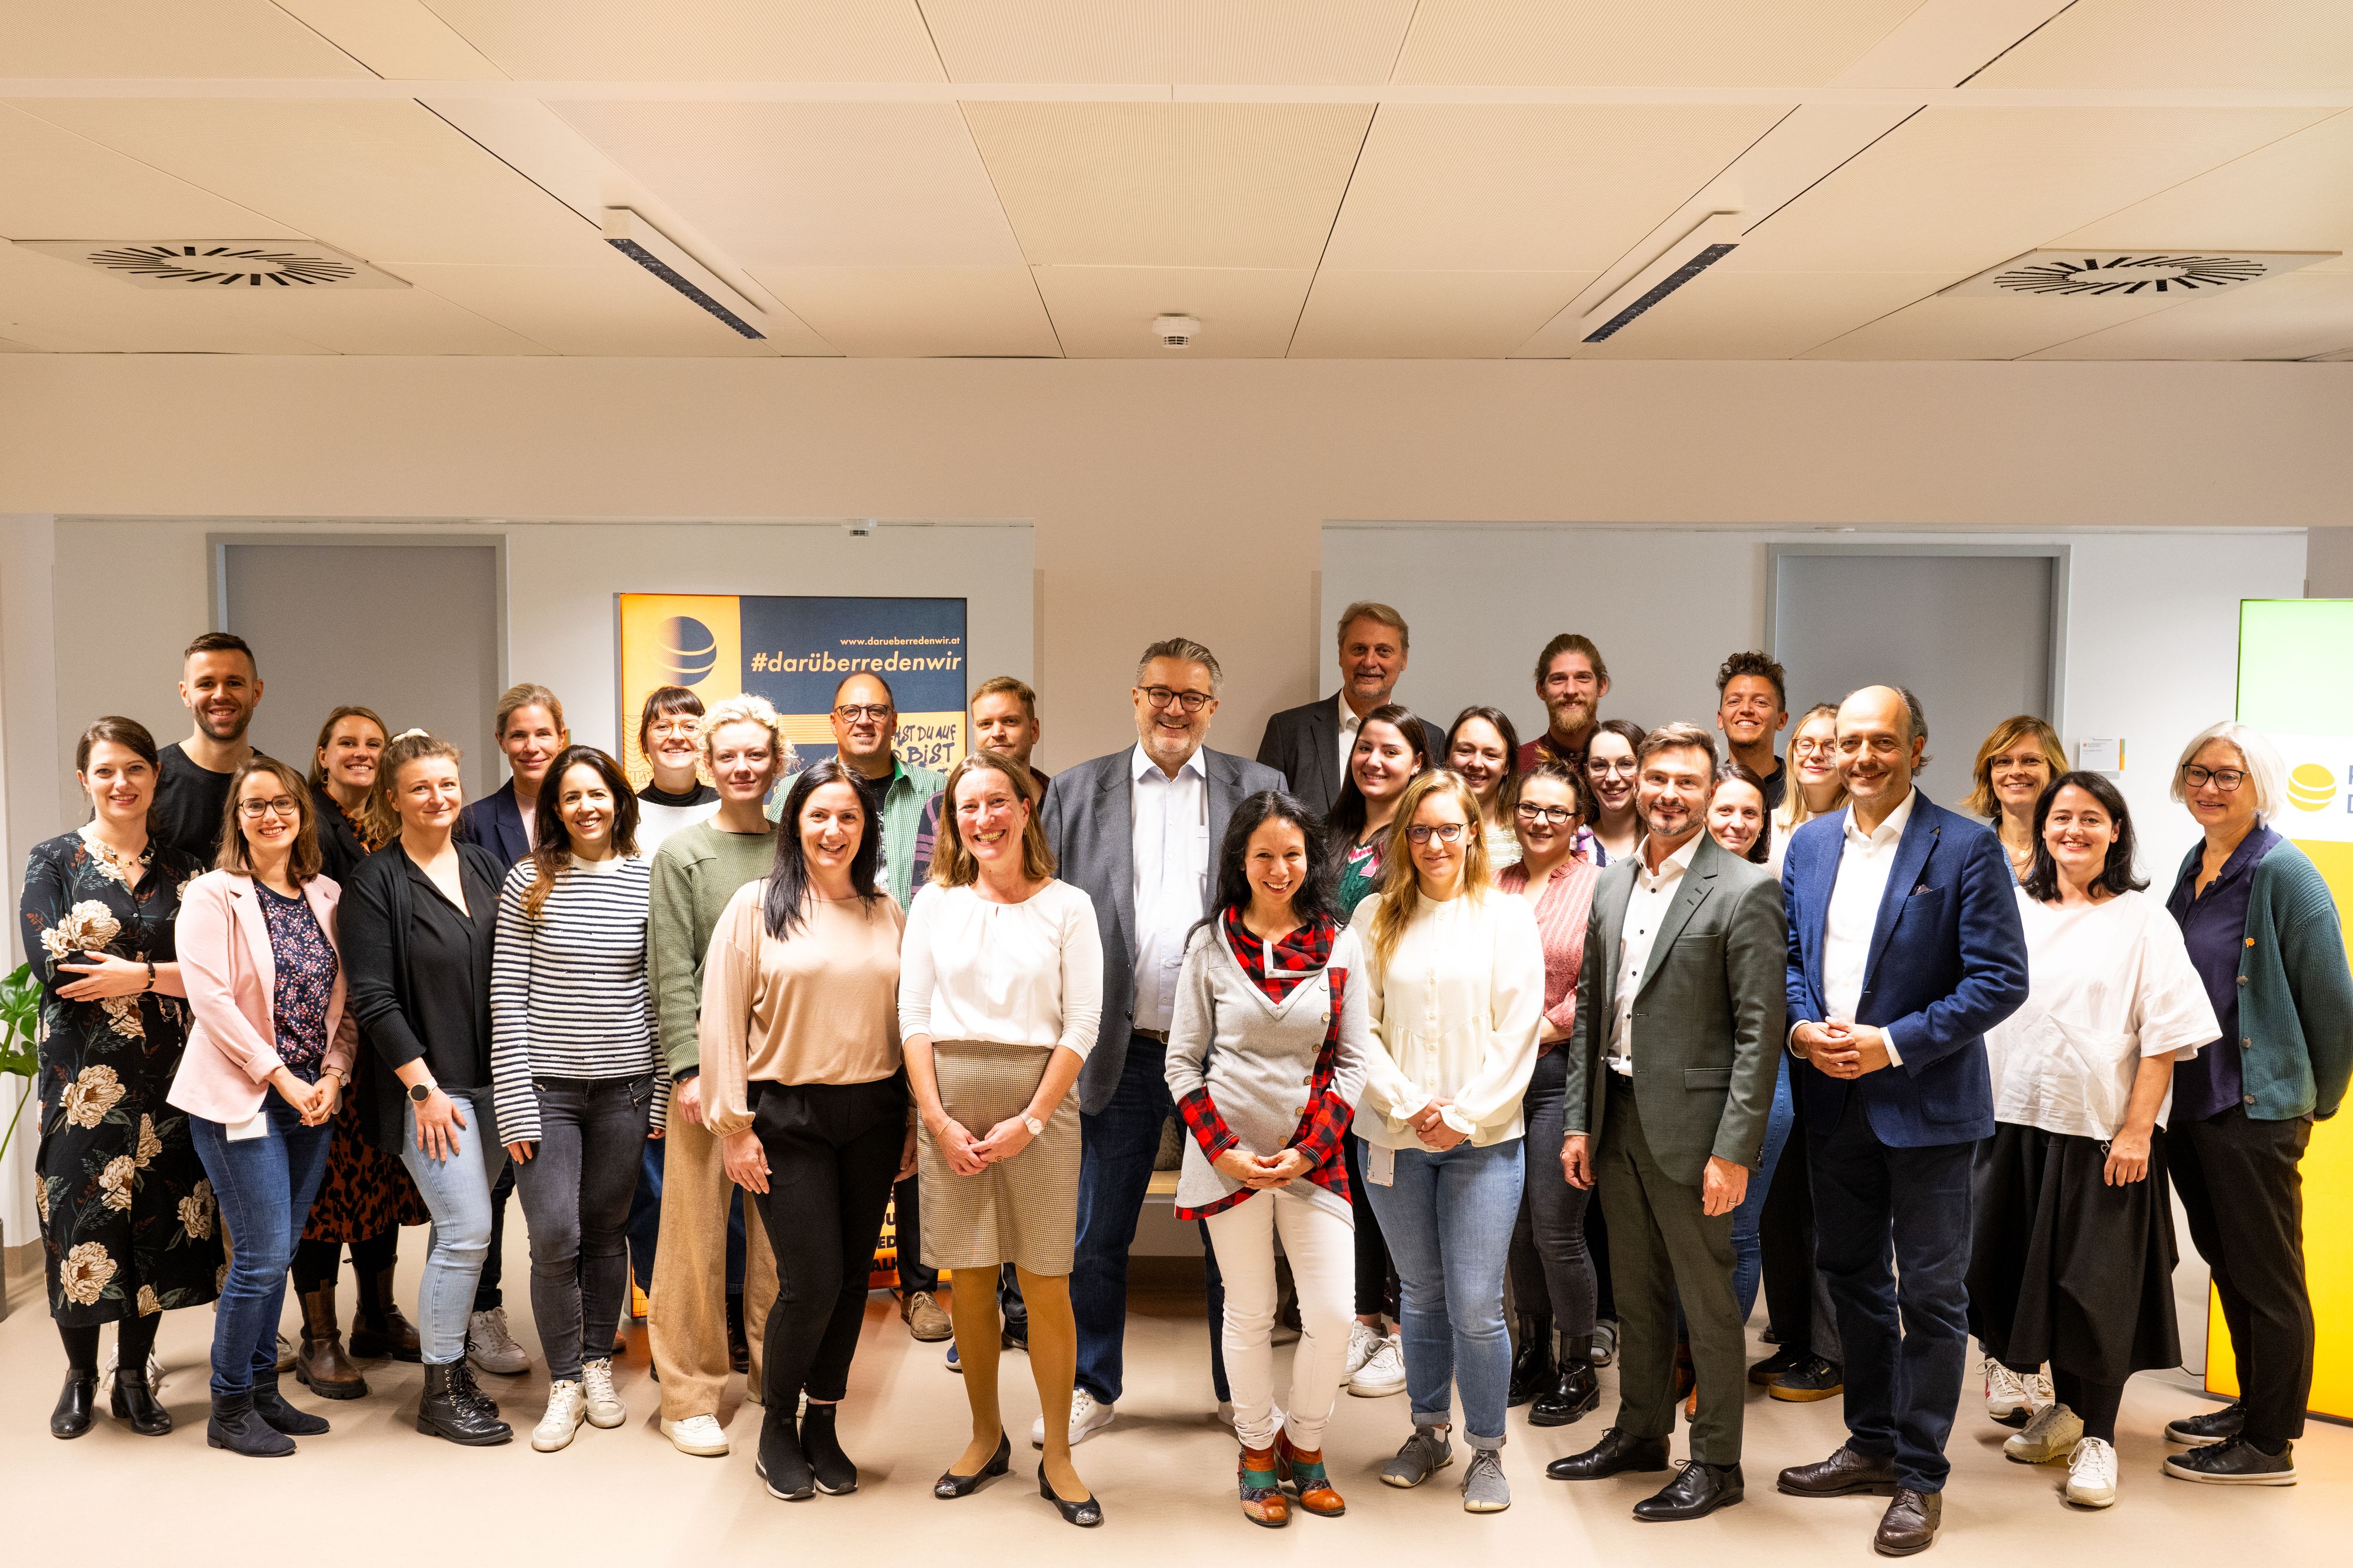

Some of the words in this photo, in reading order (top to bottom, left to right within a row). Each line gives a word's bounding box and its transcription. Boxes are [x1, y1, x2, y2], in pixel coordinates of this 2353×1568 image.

[840, 636, 961, 645] www.darueberredenwir.at
[751, 651, 962, 672] #darüberredenwir
[916, 726, 934, 741] DU
[935, 724, 956, 740] AUF
